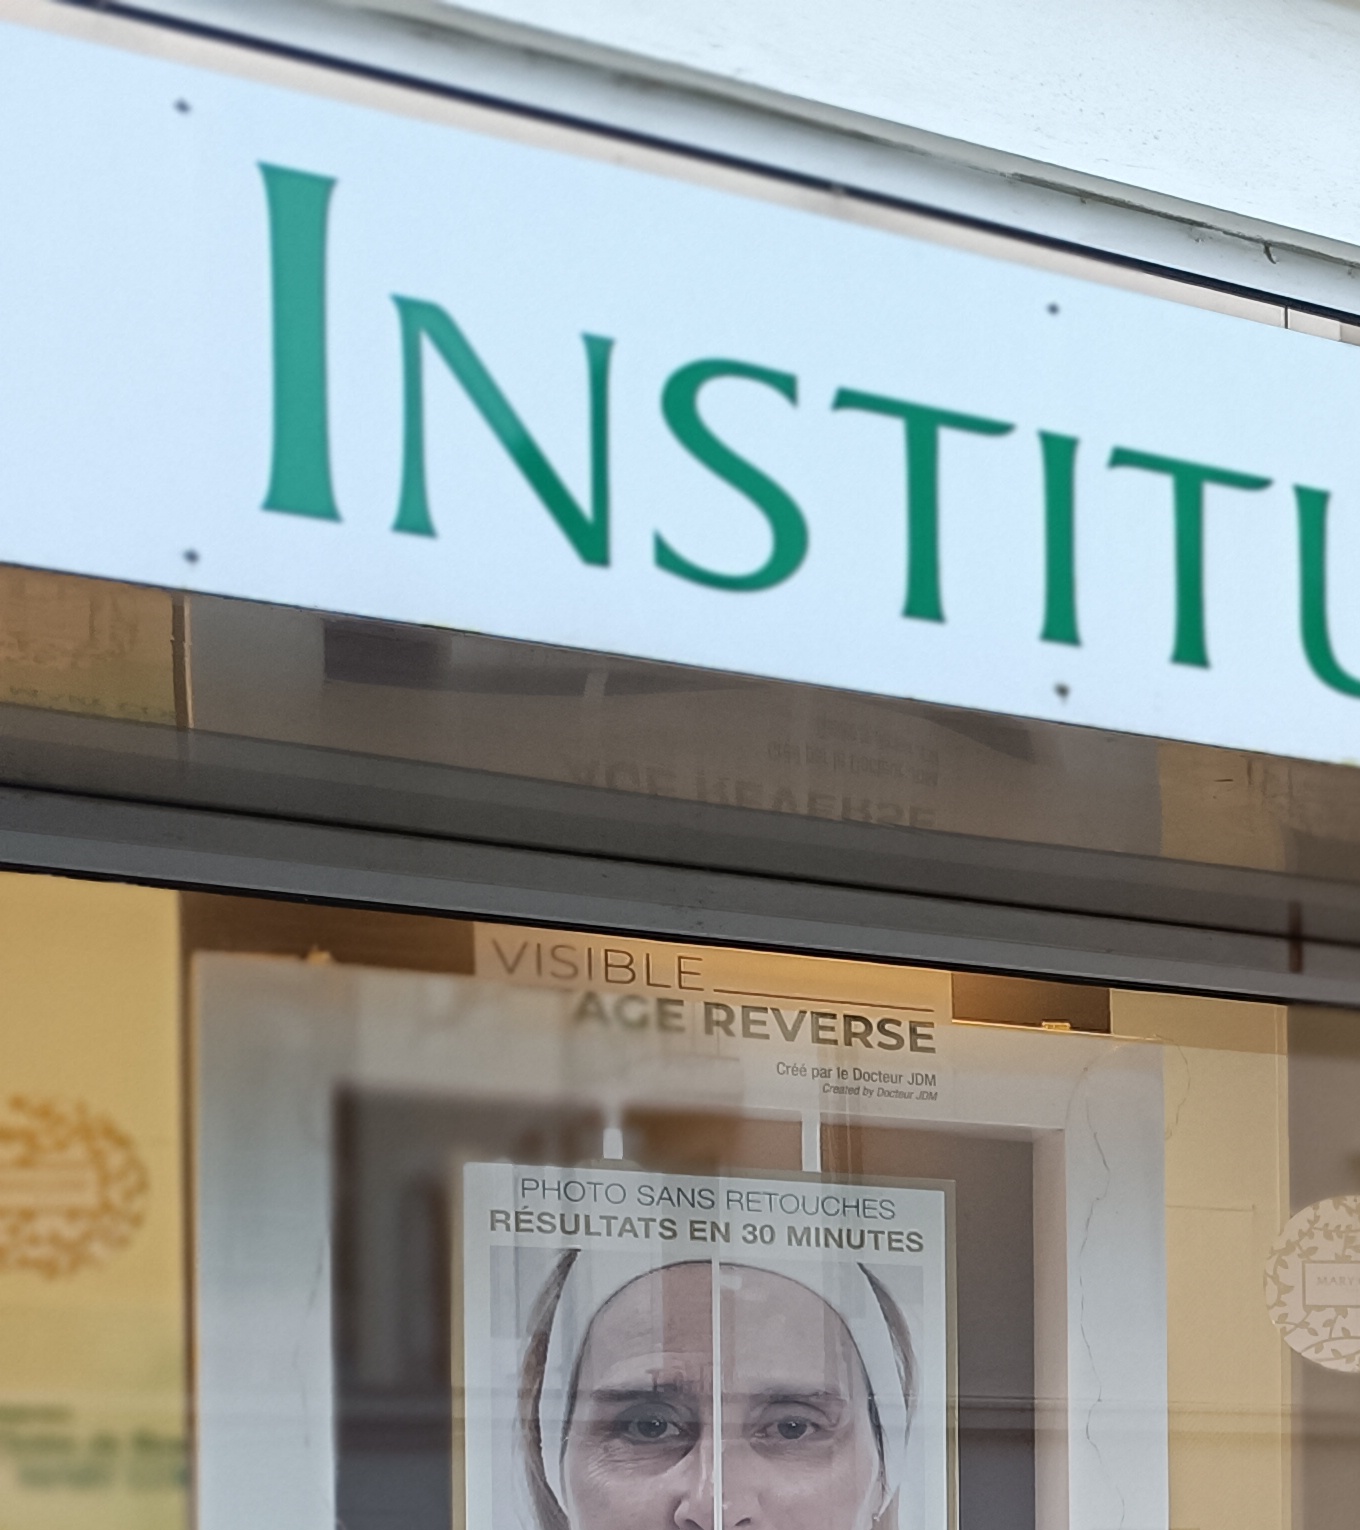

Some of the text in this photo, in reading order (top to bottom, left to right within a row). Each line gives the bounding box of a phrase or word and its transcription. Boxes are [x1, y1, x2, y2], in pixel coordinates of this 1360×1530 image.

[491, 938, 705, 992] VISIBLE
[573, 991, 937, 1054] AGE REVERSE
[776, 1061, 937, 1087] Créé par le Docteur JDM
[822, 1083, 938, 1101] Created by Docteur JDM
[520, 1177, 897, 1220] PHOTO SANS RETOUCHES
[489, 1205, 924, 1253] RÉSULTATS EN 30 MINUTES
[1316, 1276, 1354, 1286] MARY
